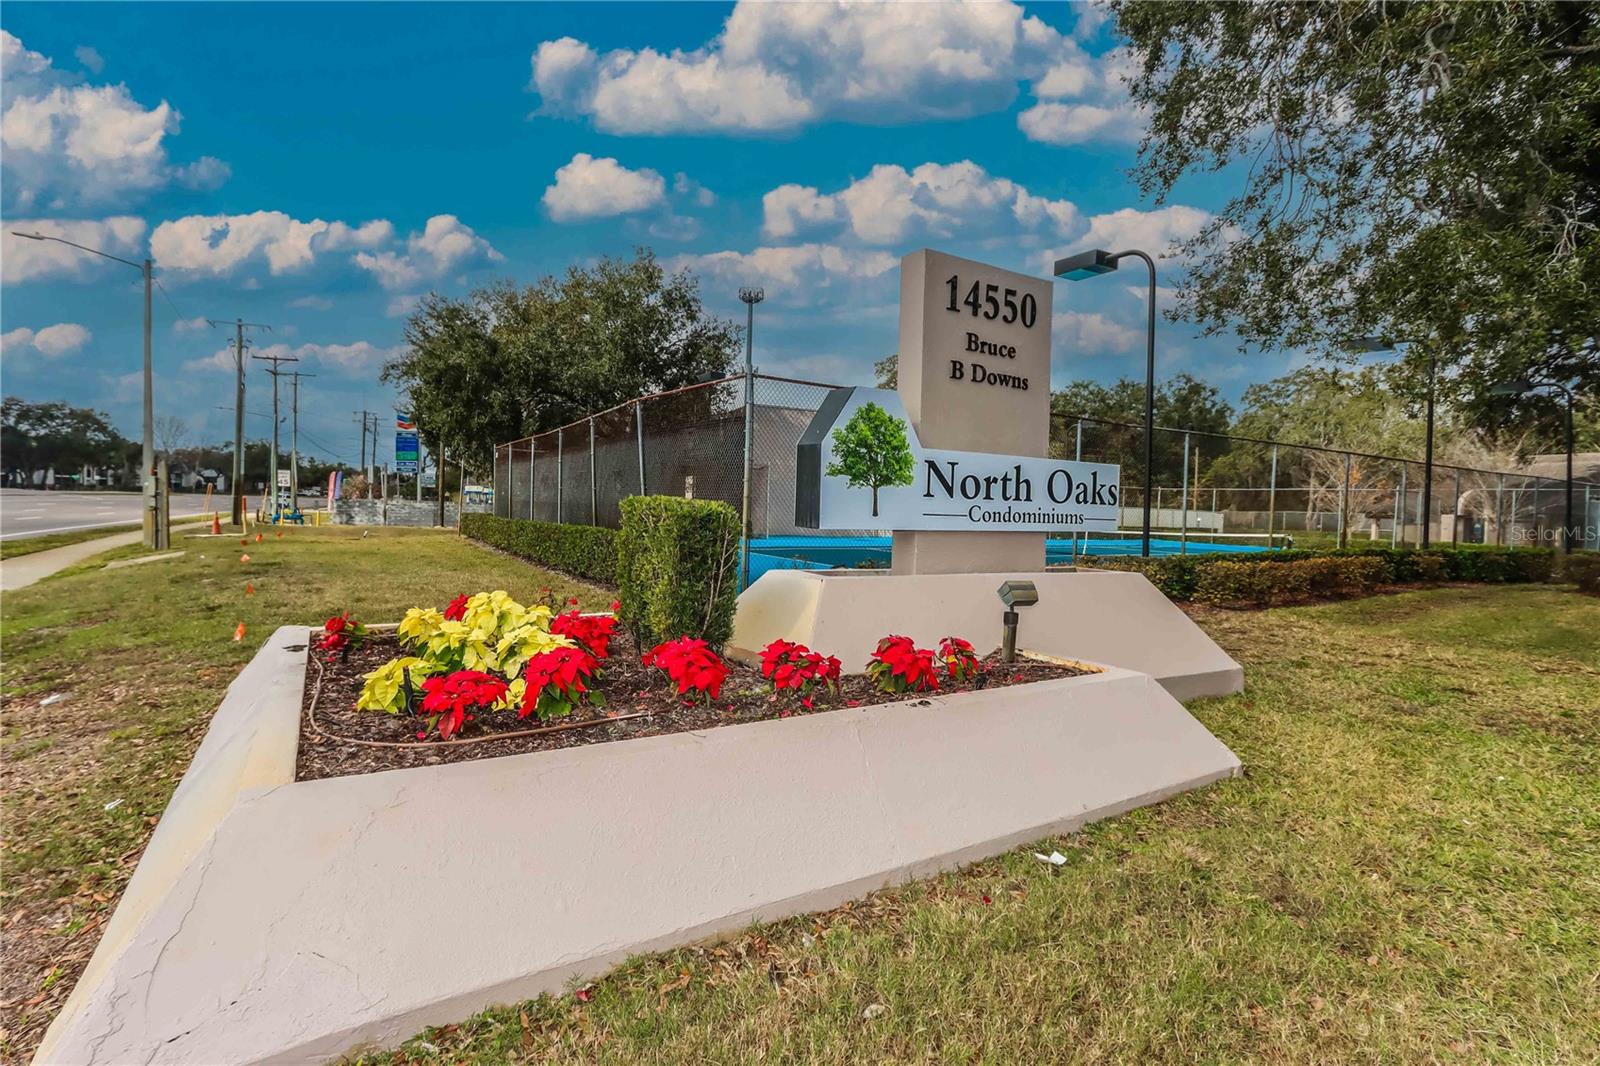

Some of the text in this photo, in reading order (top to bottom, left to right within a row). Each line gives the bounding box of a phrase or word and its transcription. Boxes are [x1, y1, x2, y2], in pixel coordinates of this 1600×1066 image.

[946, 275, 1037, 328] 14550
[965, 332, 1016, 359] Bruce
[950, 360, 1029, 390] B Downs
[923, 459, 1117, 506] North Oaks
[968, 505, 1084, 524] Condominiums
